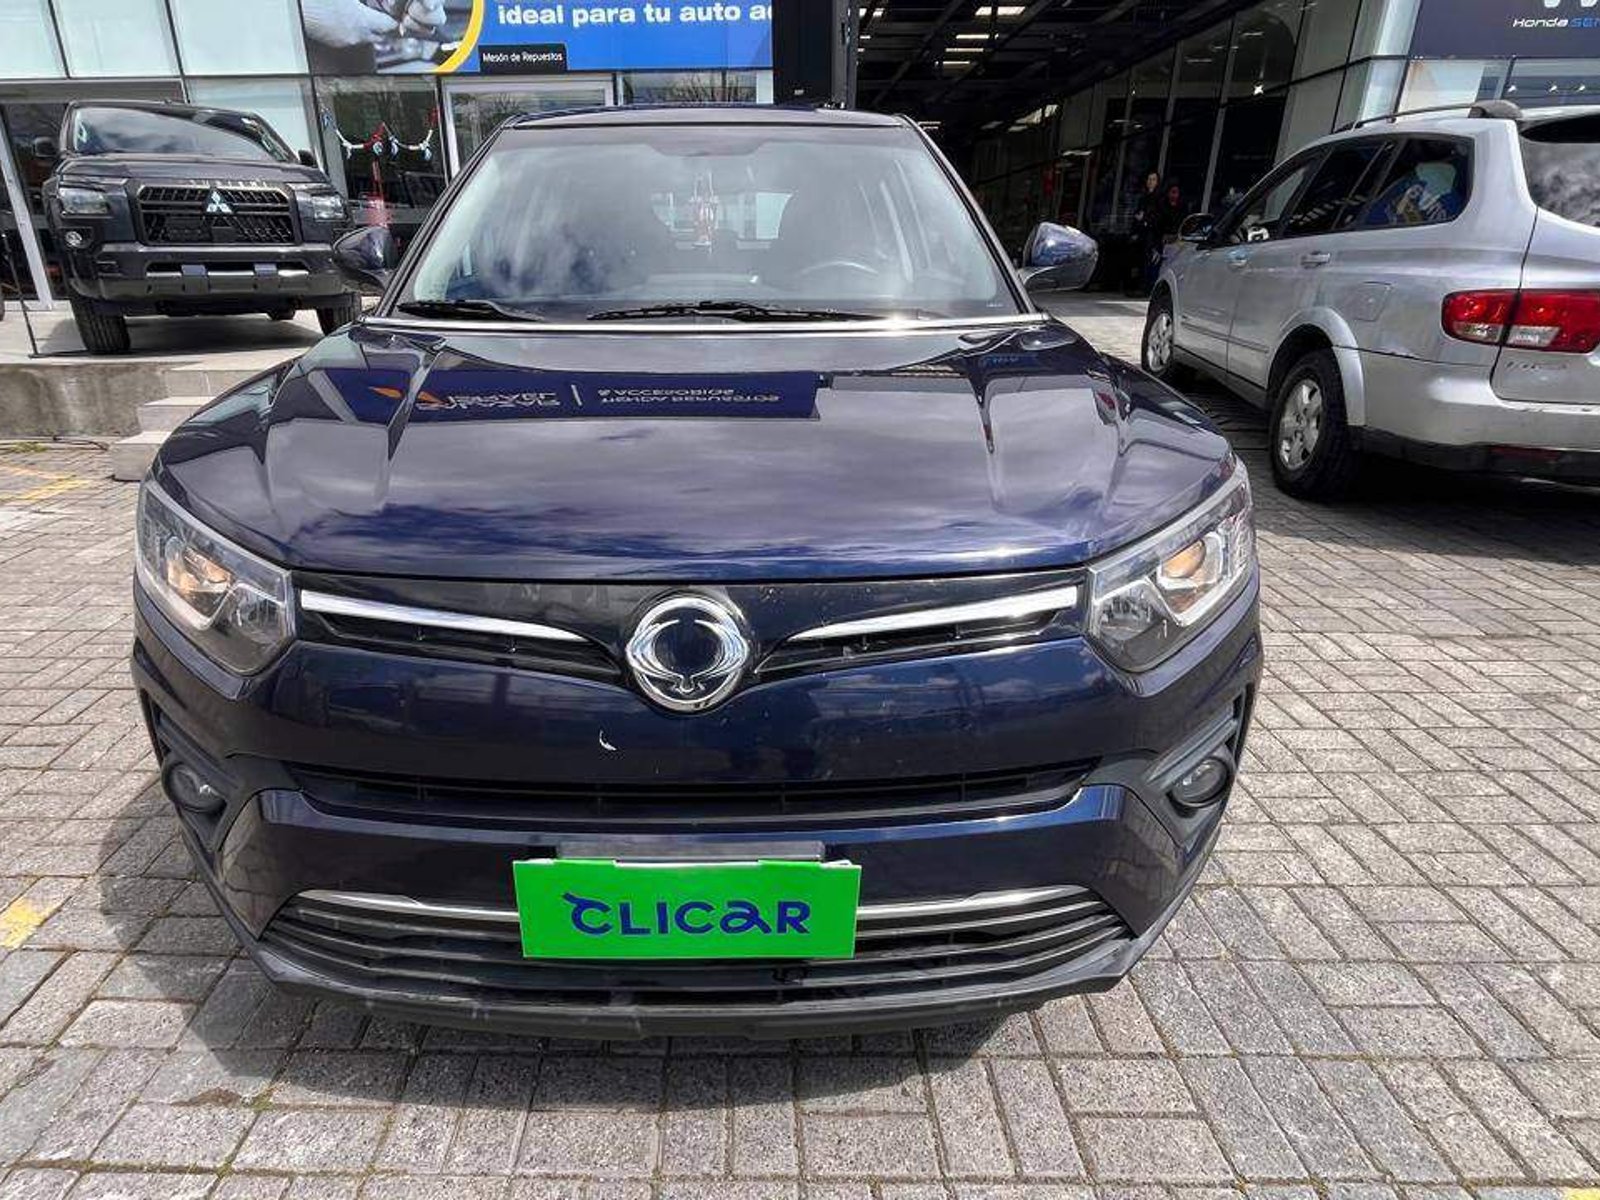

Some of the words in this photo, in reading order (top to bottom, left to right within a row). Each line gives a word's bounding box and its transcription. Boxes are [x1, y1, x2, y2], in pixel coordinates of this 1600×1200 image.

[498, 4, 564, 25] ideal
[572, 5, 636, 28] para
[643, 3, 671, 22] tu
[680, 2, 741, 21] auto
[510, 53, 521, 62] de
[522, 51, 564, 63] Repuestos
